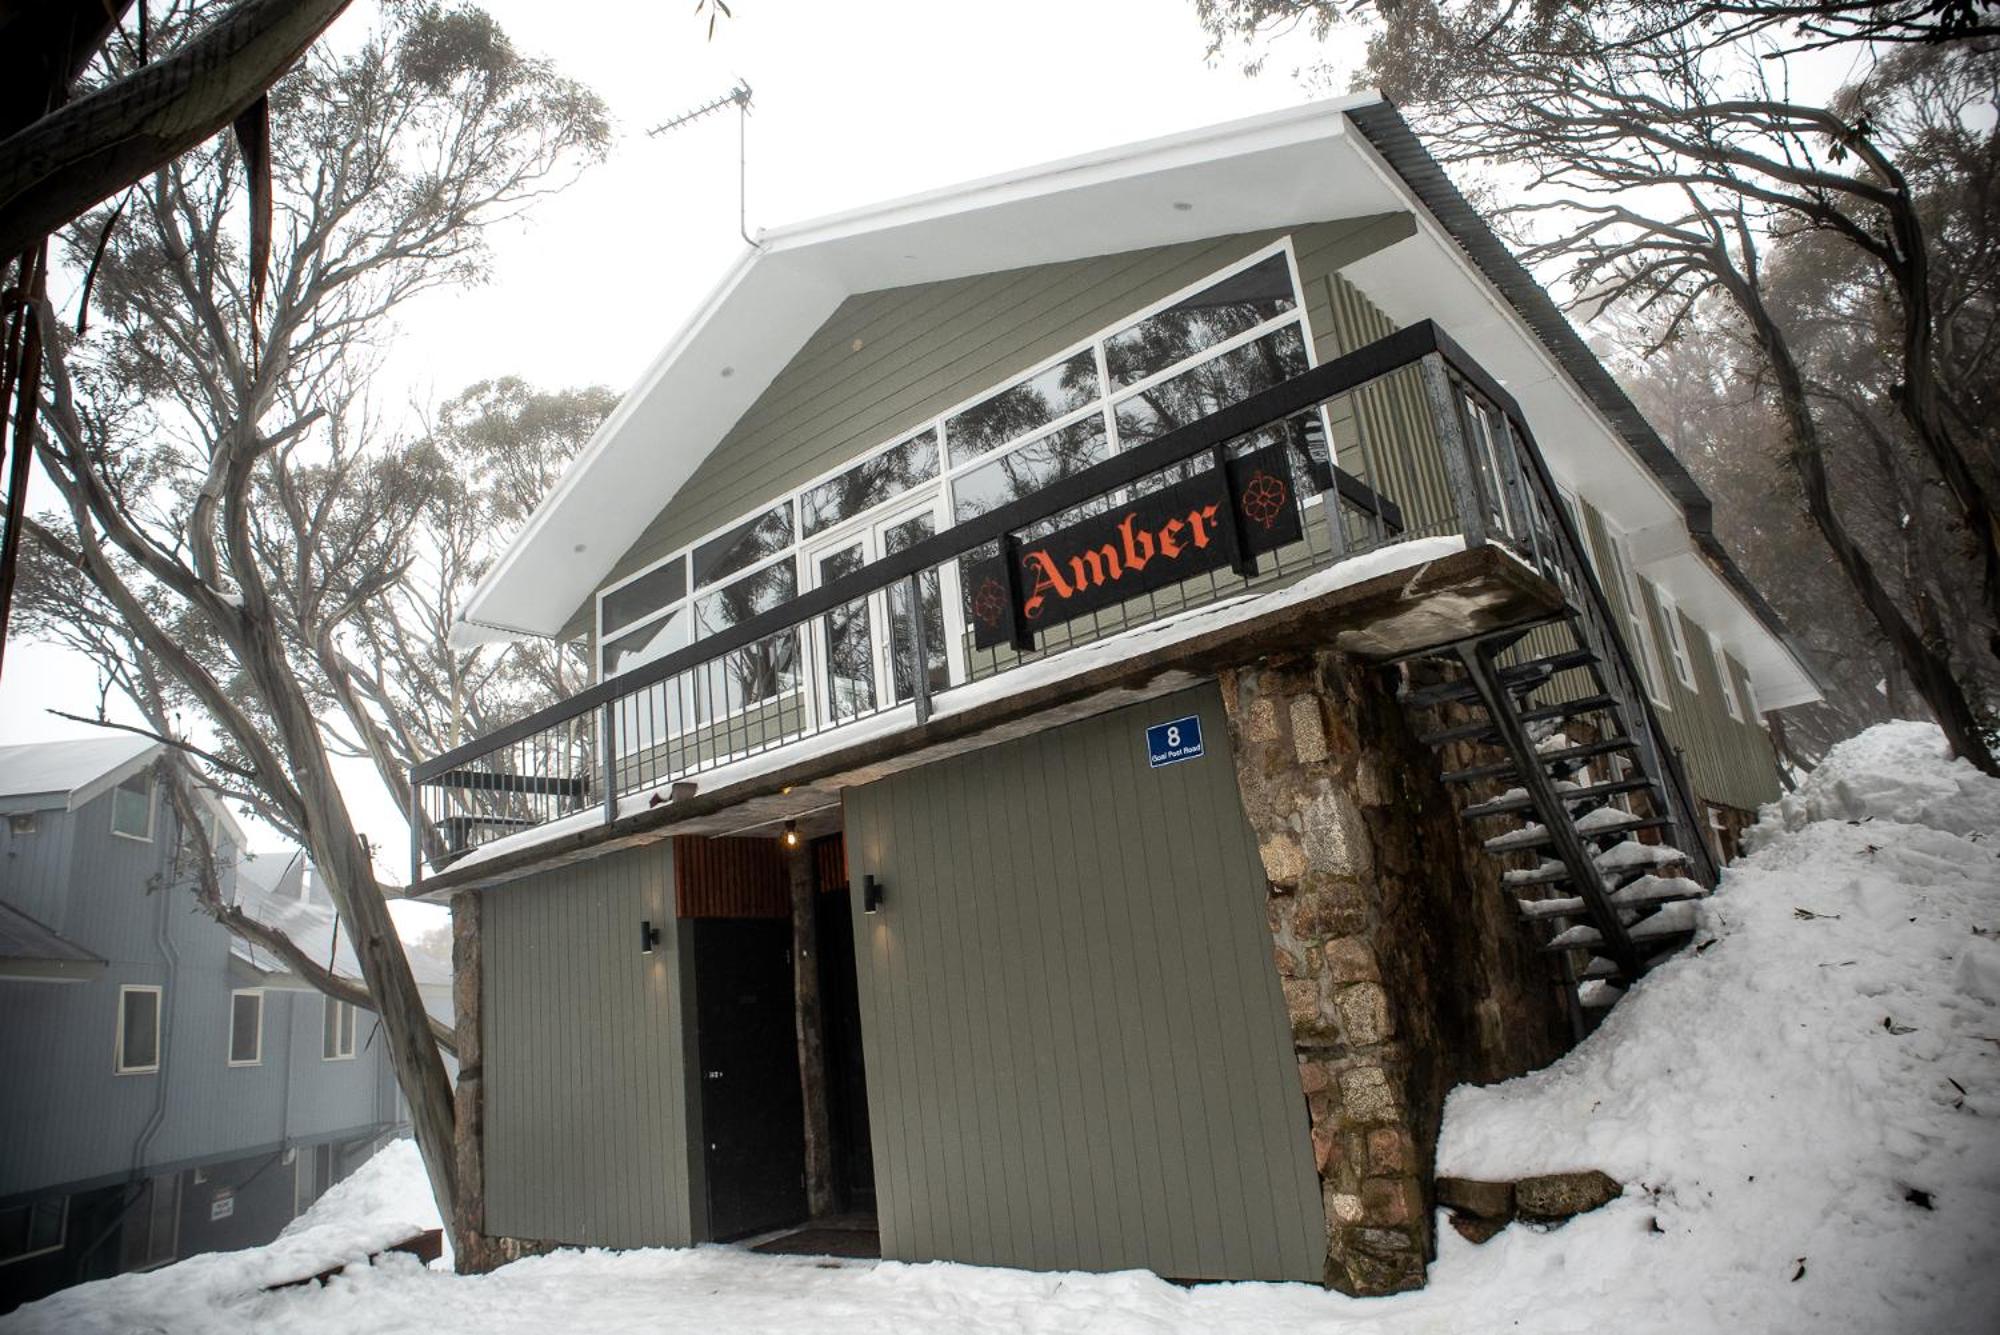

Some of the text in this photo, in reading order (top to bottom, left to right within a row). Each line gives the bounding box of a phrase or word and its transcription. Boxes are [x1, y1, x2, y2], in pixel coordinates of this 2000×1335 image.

[1023, 503, 1219, 618] Amber
[1167, 726, 1180, 747] 8
[1168, 748, 1183, 757] Post
[1183, 744, 1201, 754] Road
